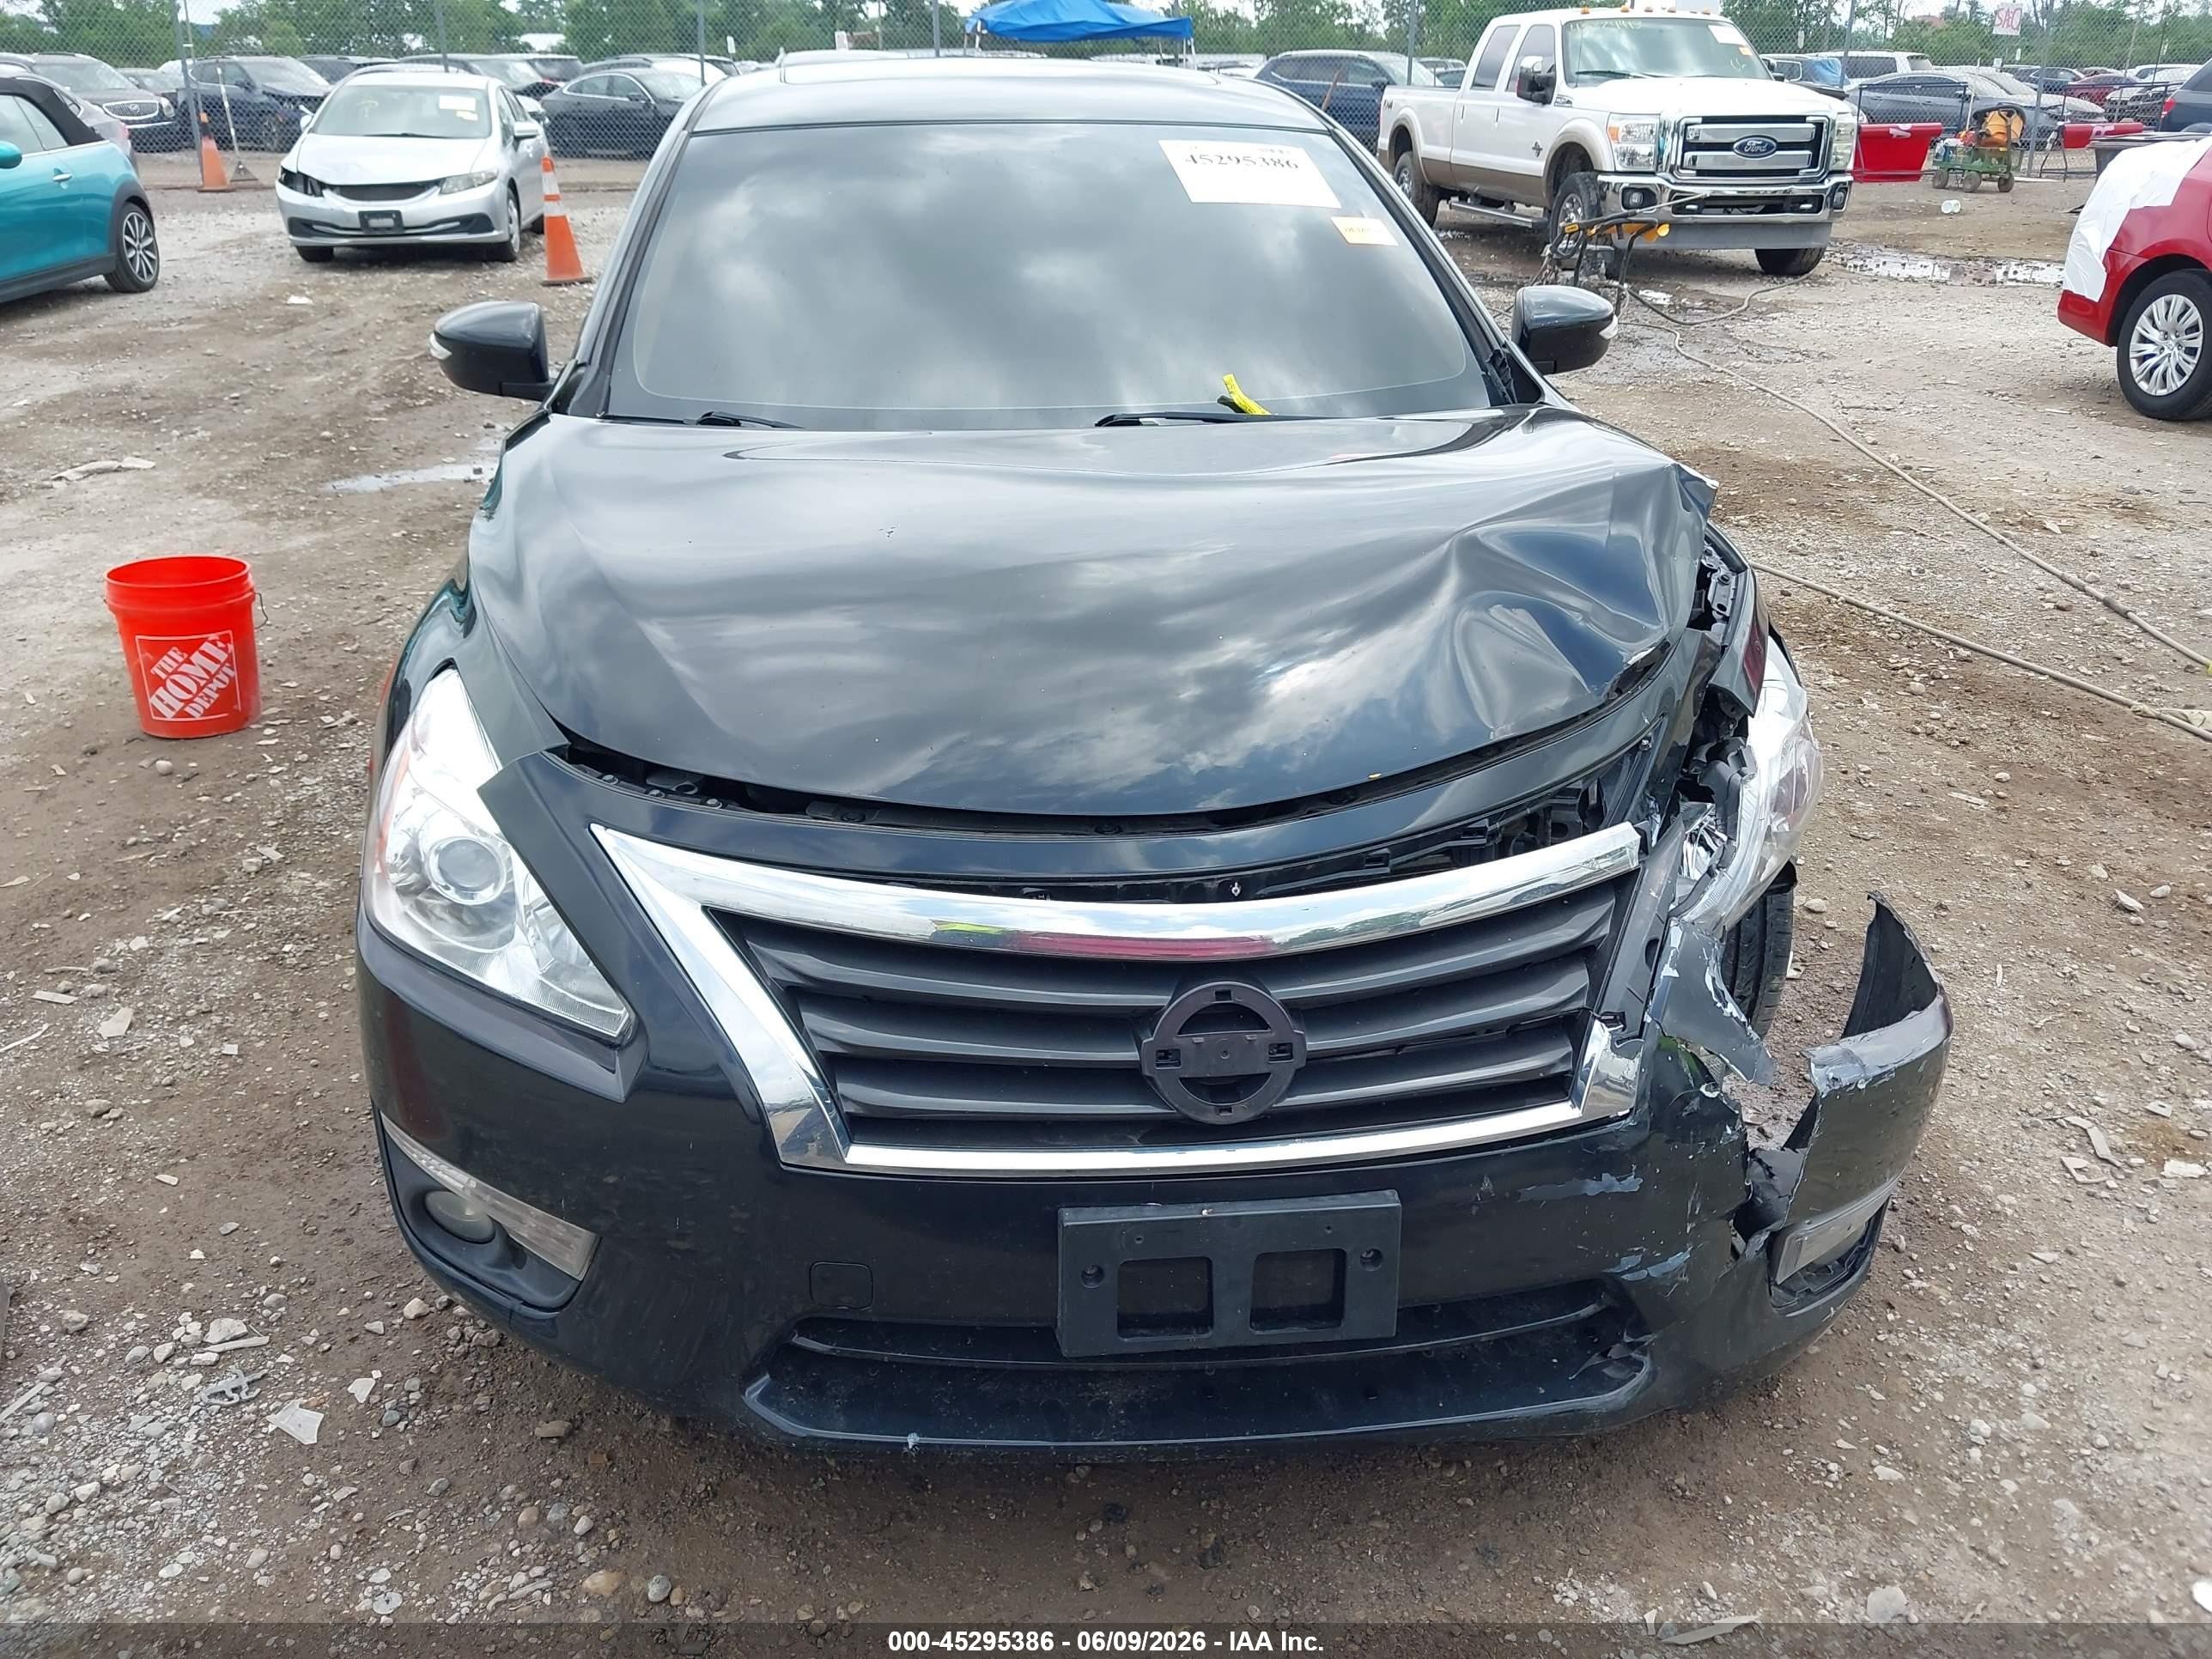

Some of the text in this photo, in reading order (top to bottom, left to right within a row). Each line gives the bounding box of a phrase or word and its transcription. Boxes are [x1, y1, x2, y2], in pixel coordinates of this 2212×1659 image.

[1744, 140, 1769, 153] Ford
[149, 635, 233, 720] HOME
[150, 646, 189, 680] THE
[184, 662, 236, 719] DEPOT
